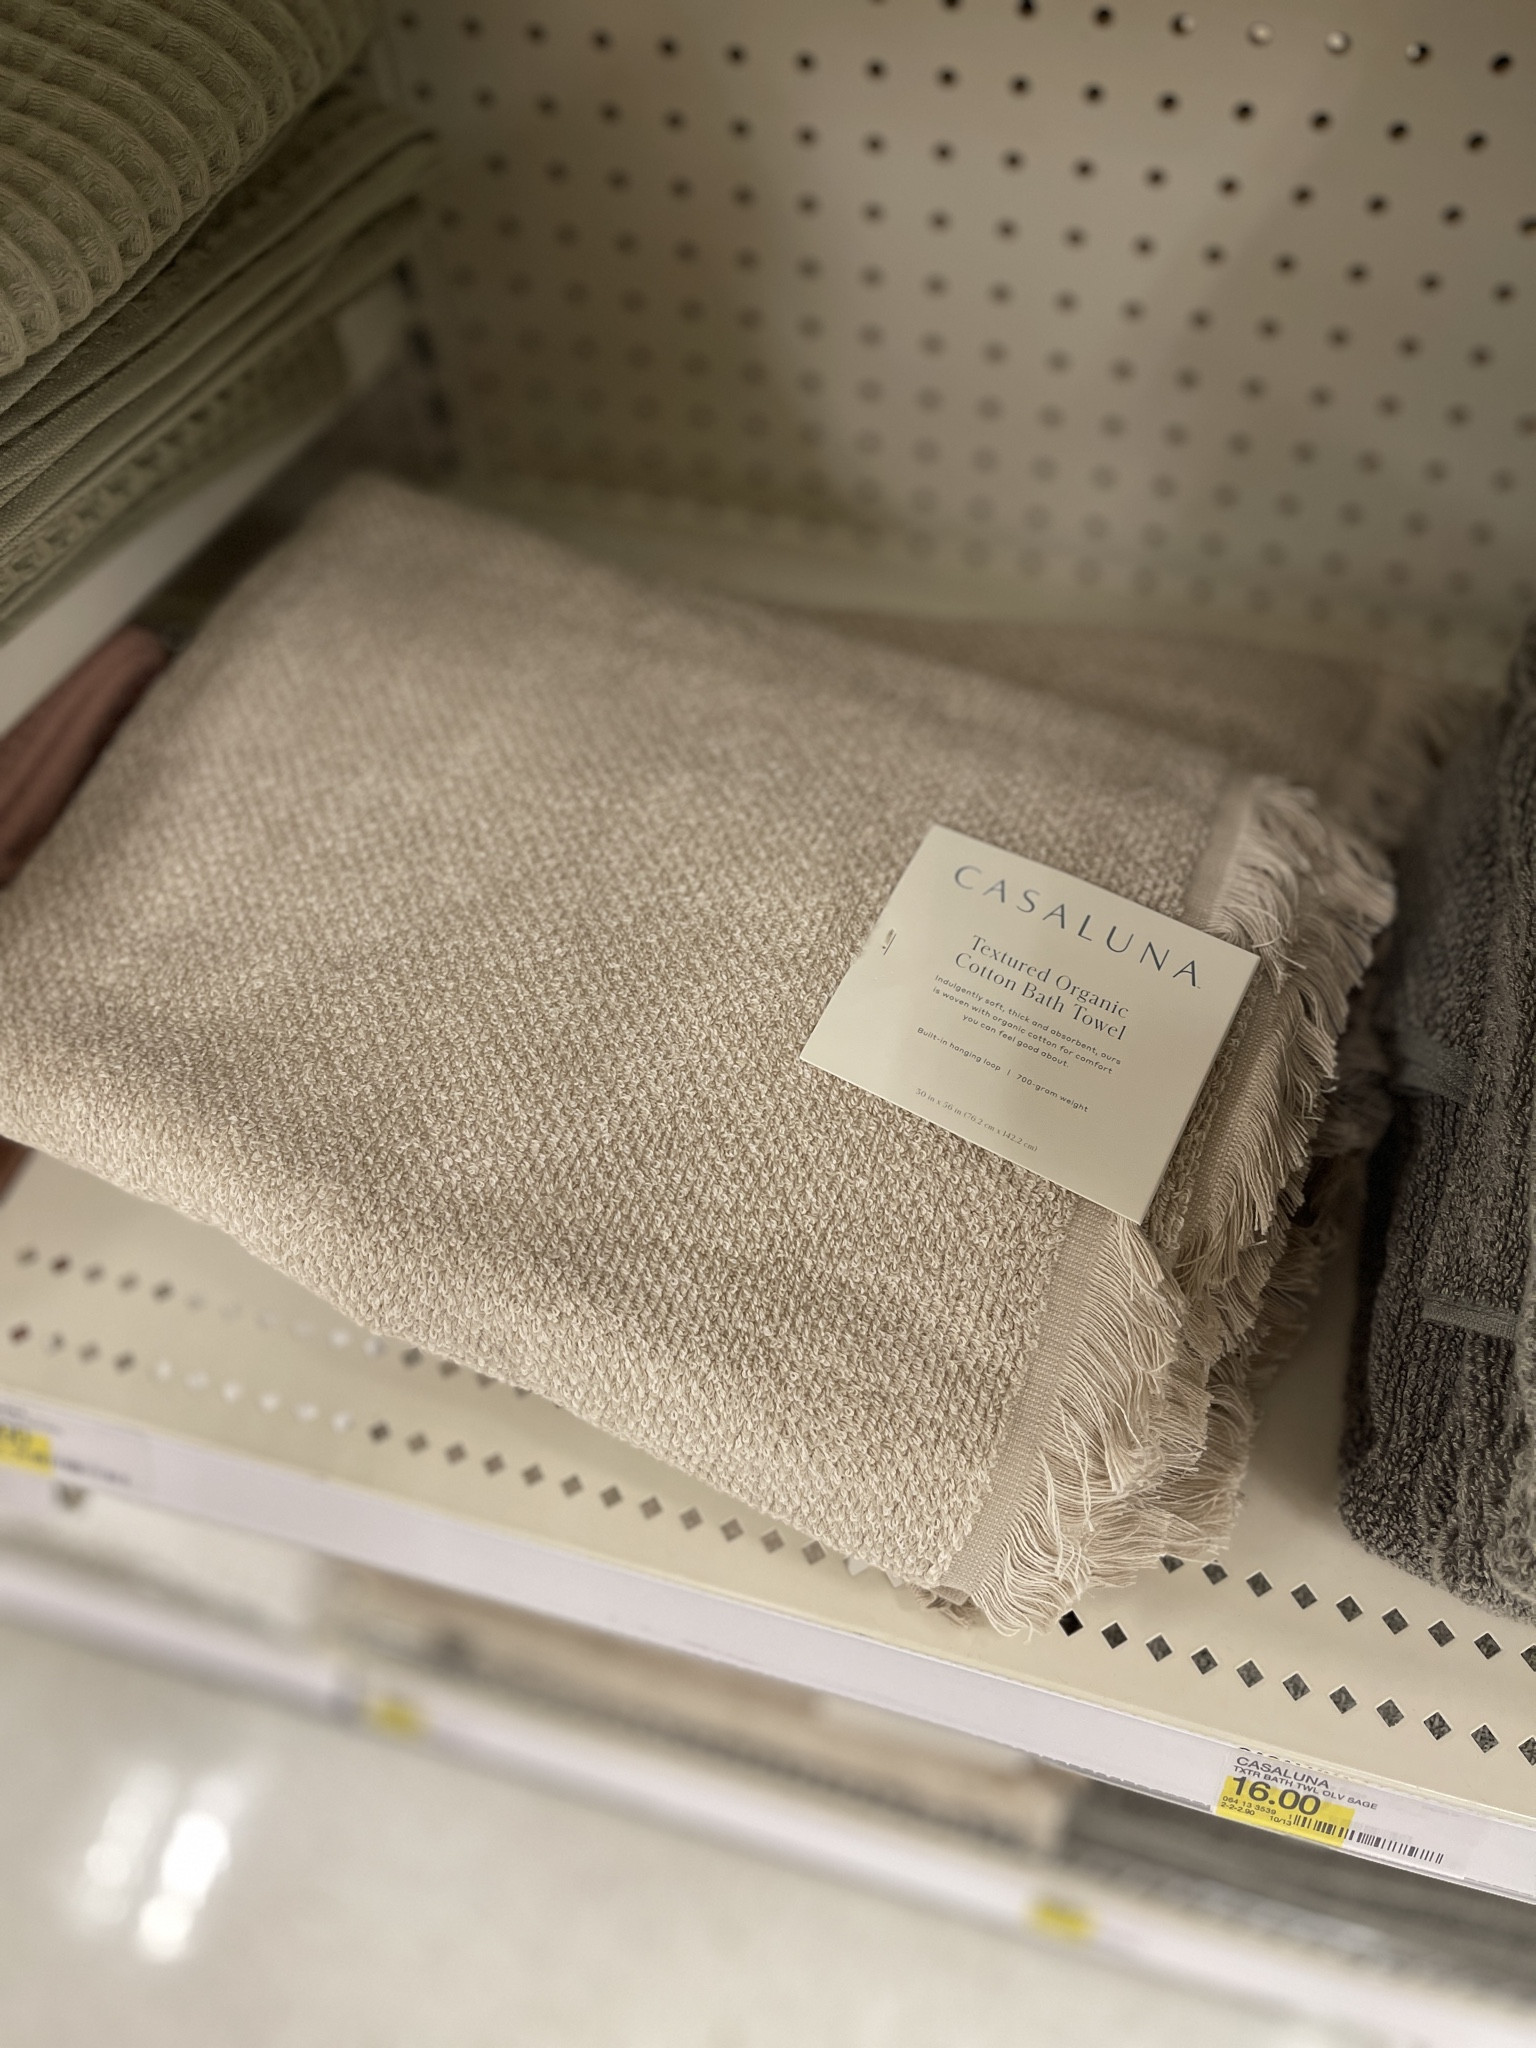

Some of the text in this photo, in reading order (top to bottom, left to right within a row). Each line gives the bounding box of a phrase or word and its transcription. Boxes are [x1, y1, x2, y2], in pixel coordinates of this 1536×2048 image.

[954, 866, 1201, 989] CASALUNA
[955, 952, 1127, 1041] Cotton Bath Towel
[972, 935, 1129, 1018] Textured Organic
[932, 986, 1114, 1076] is woven with organic cotton for comfort
[933, 974, 1122, 1066] Indulgently soft, thick and absorbent, ours
[961, 1013, 1071, 1069] you can feel good about.
[916, 1025, 949, 1047] Built-in
[948, 1041, 983, 1064] hanging
[982, 1057, 1002, 1073] loop
[1015, 1073, 1059, 1099] 700-gram
[1058, 1093, 1090, 1114] weight
[926, 1093, 937, 1103] in
[941, 1100, 955, 1112] 56
[953, 1107, 963, 1116] in
[962, 1110, 984, 1127] (76.2
[983, 1122, 996, 1132] cm
[1001, 1129, 1024, 1146] 142.2
[1022, 1141, 1039, 1153] cm)
[1232, 1776, 1322, 1816] 16.00
[1233, 1764, 1378, 1810] TXTR BATH TWL OLV SAGE
[1236, 1756, 1329, 1790] CASALUNA
[1220, 1801, 1292, 1827] 2-2-2.90 10/13
[1241, 1800, 1253, 1809] 13
[1254, 1804, 1277, 1816] 3539
